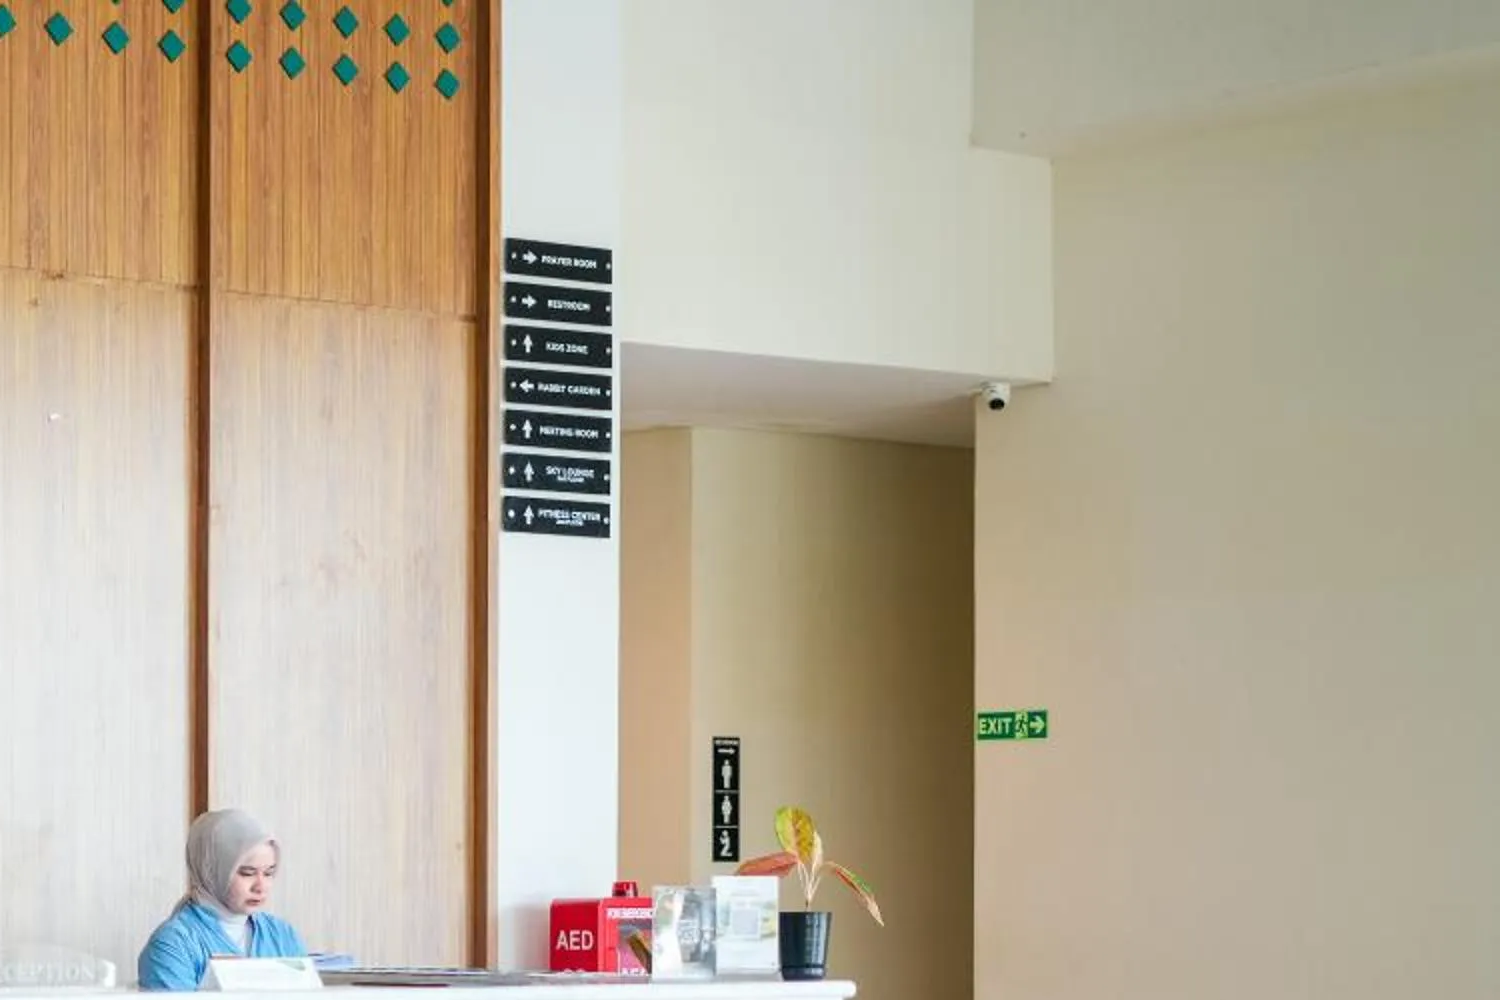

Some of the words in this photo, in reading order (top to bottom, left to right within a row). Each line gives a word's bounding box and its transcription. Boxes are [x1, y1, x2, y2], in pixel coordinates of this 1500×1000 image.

[573, 257, 597, 269] ROOM
[547, 299, 591, 312] RESTROOM
[539, 425, 573, 437] MEETING
[575, 428, 599, 439] ROOM
[979, 718, 1012, 735] EXIT
[556, 929, 594, 951] AED
